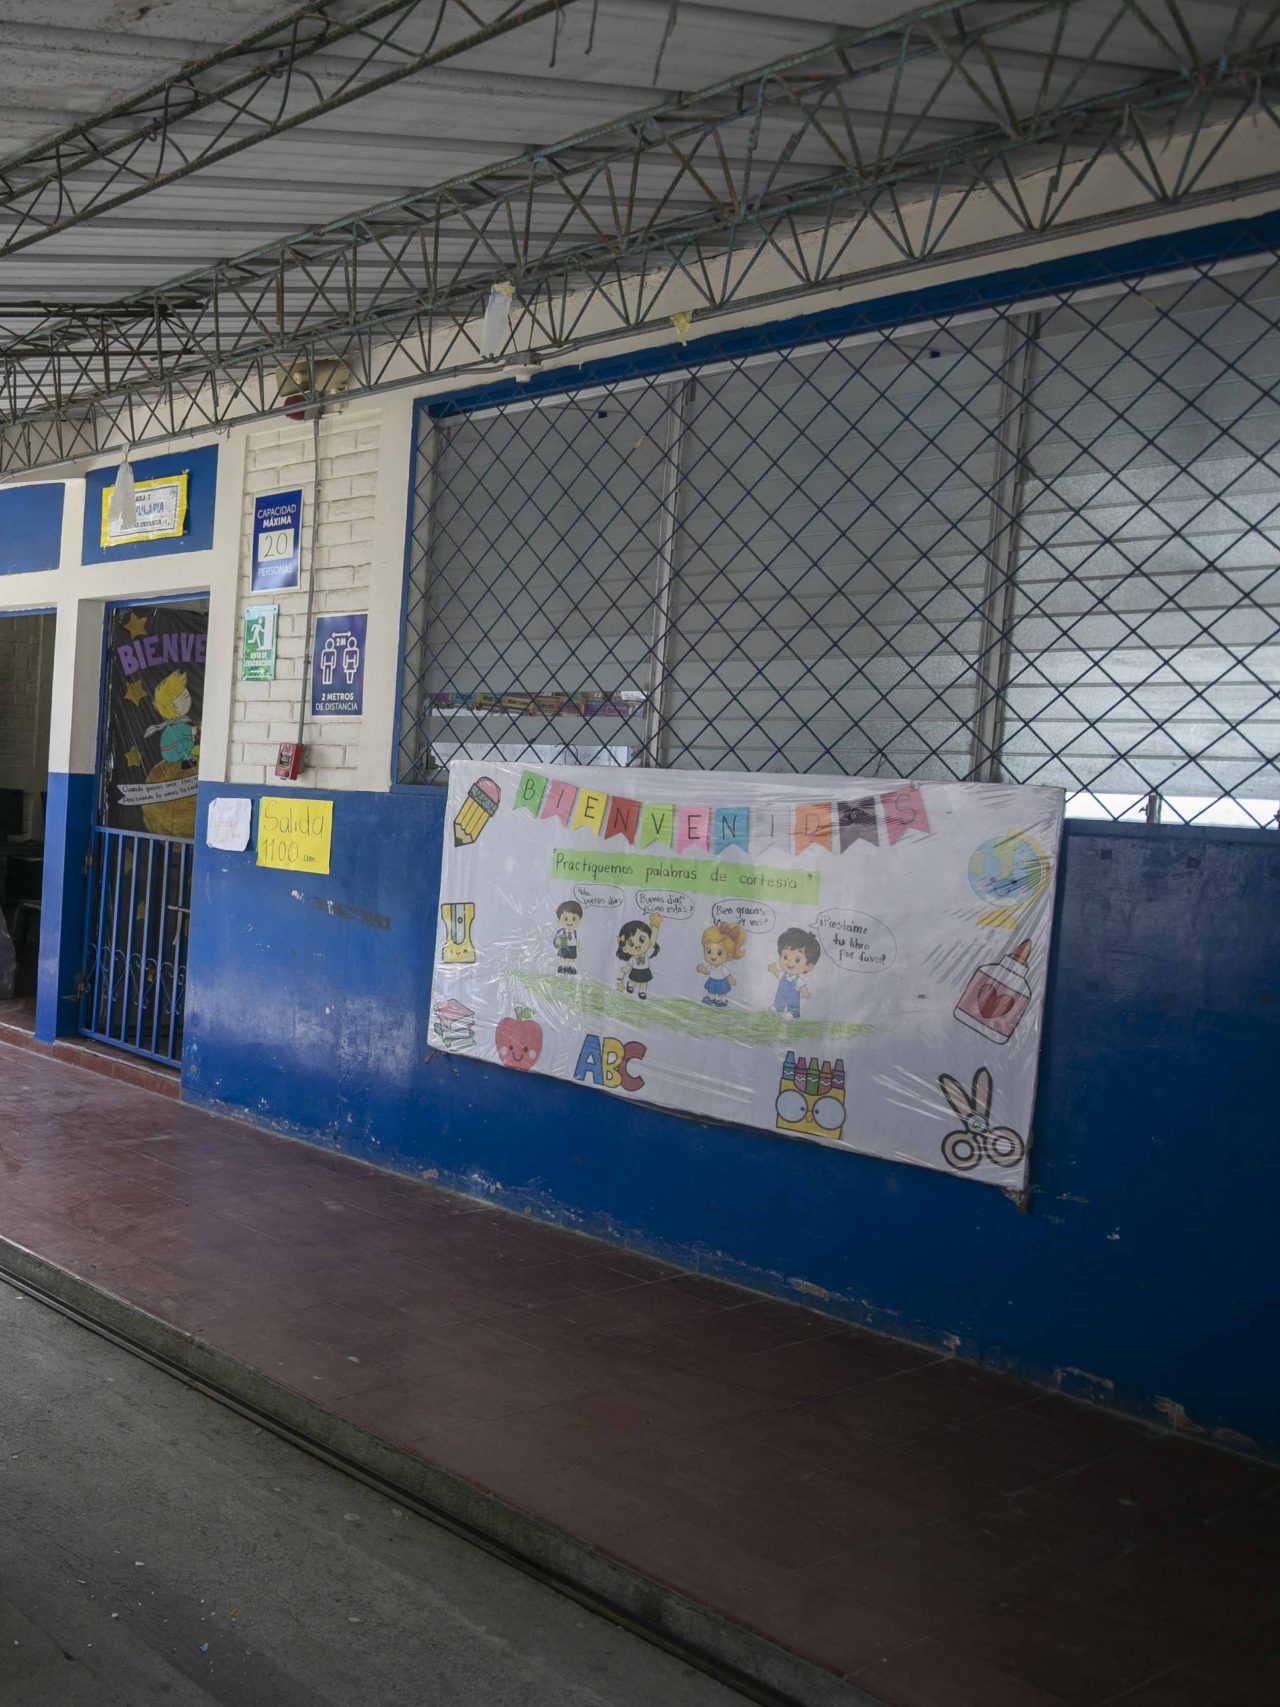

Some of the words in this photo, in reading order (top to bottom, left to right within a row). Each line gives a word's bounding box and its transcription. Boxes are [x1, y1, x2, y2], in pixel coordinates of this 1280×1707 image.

[257, 504, 297, 519] CAPACIDAD
[262, 515, 292, 529] MÁXIMA
[264, 532, 288, 558] 20
[257, 564, 293, 577] PERSONAS
[321, 693, 326, 701] 2
[326, 692, 355, 701] METROS
[315, 702, 324, 711] DE
[325, 702, 358, 711] DISTANCIA
[522, 778, 917, 841] BIENVENIDS
[263, 800, 324, 839] Salida
[645, 862, 697, 883] palabras
[710, 867, 728, 882] de
[716, 905, 733, 915] Bien
[832, 933, 846, 946] tu
[850, 937, 871, 950] libro
[573, 1033, 647, 1092] ABC
